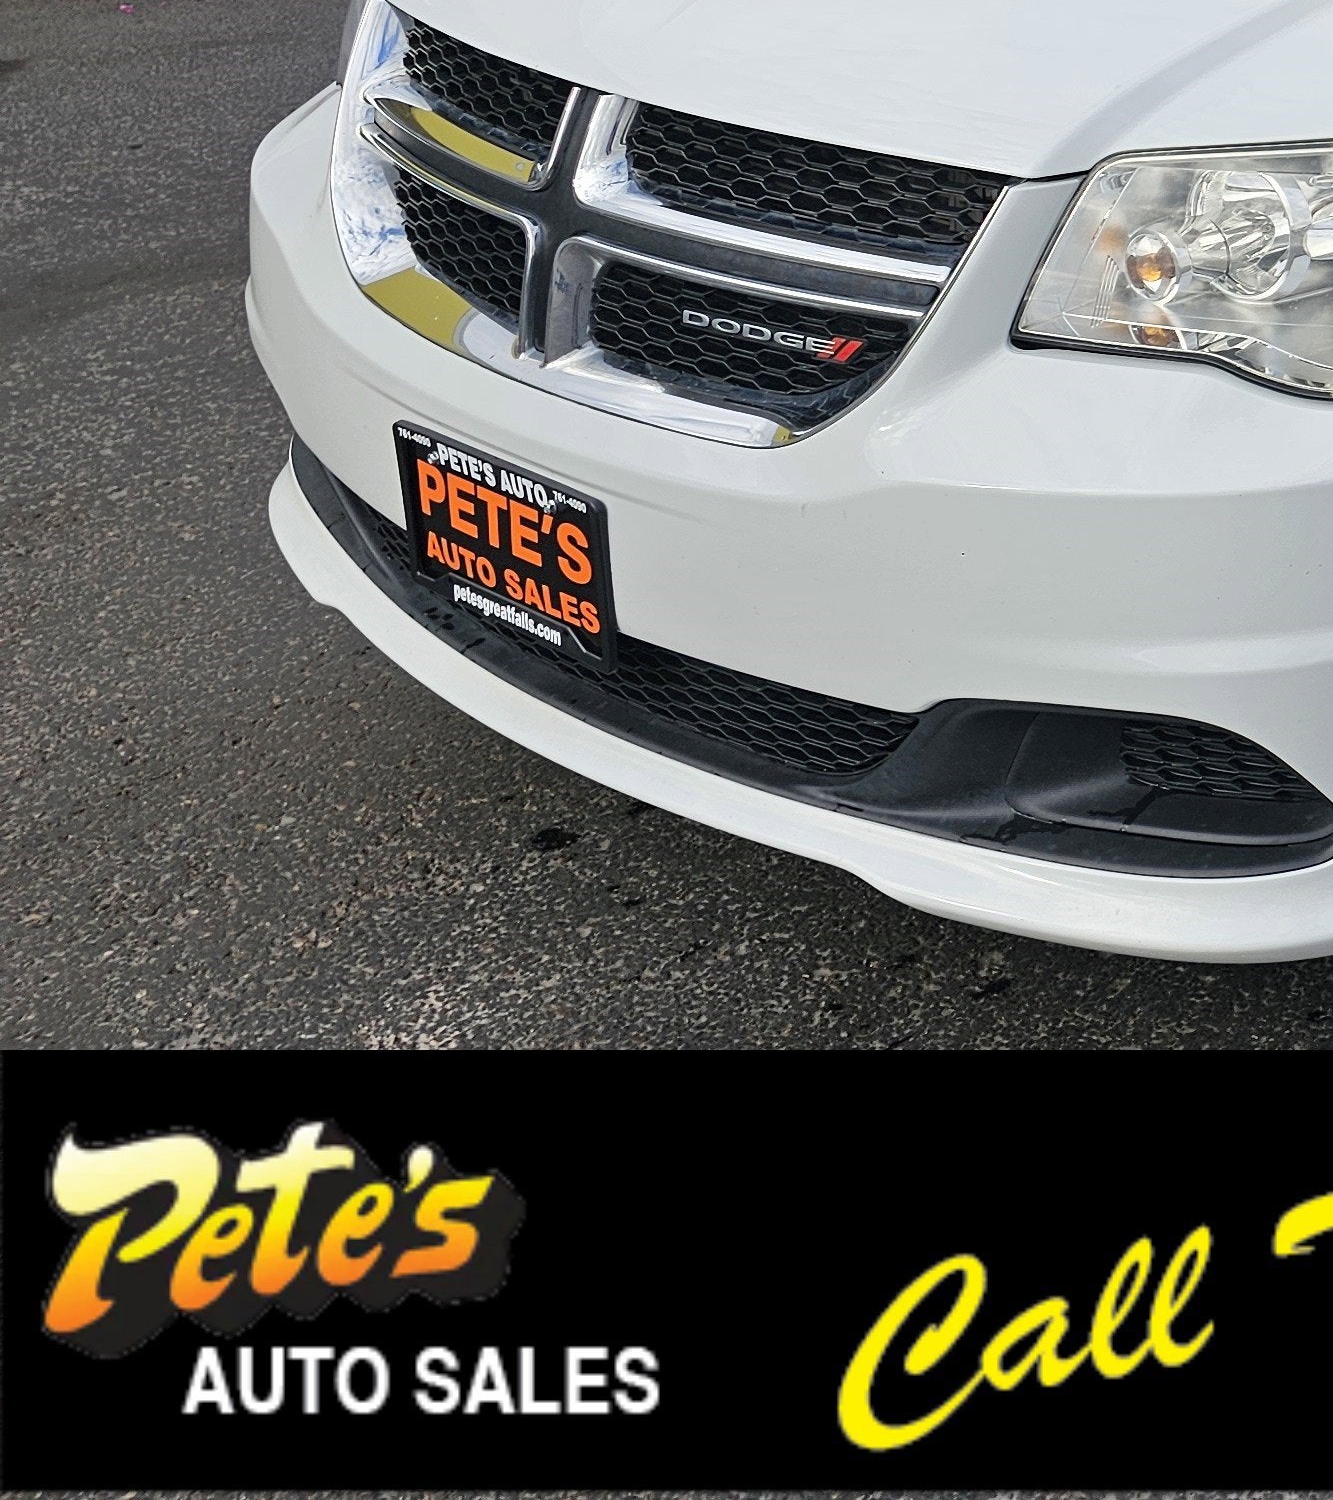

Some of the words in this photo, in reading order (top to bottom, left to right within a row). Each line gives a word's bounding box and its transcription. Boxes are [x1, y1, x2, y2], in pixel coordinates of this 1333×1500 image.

[682, 309, 836, 356] DODGE
[436, 442, 497, 488] PETE'S
[501, 469, 549, 509] AUTO
[416, 458, 592, 585] PETE'S
[427, 530, 497, 588] AUTO
[503, 568, 600, 634] SALES
[453, 583, 562, 647] petesgreatfalls.com
